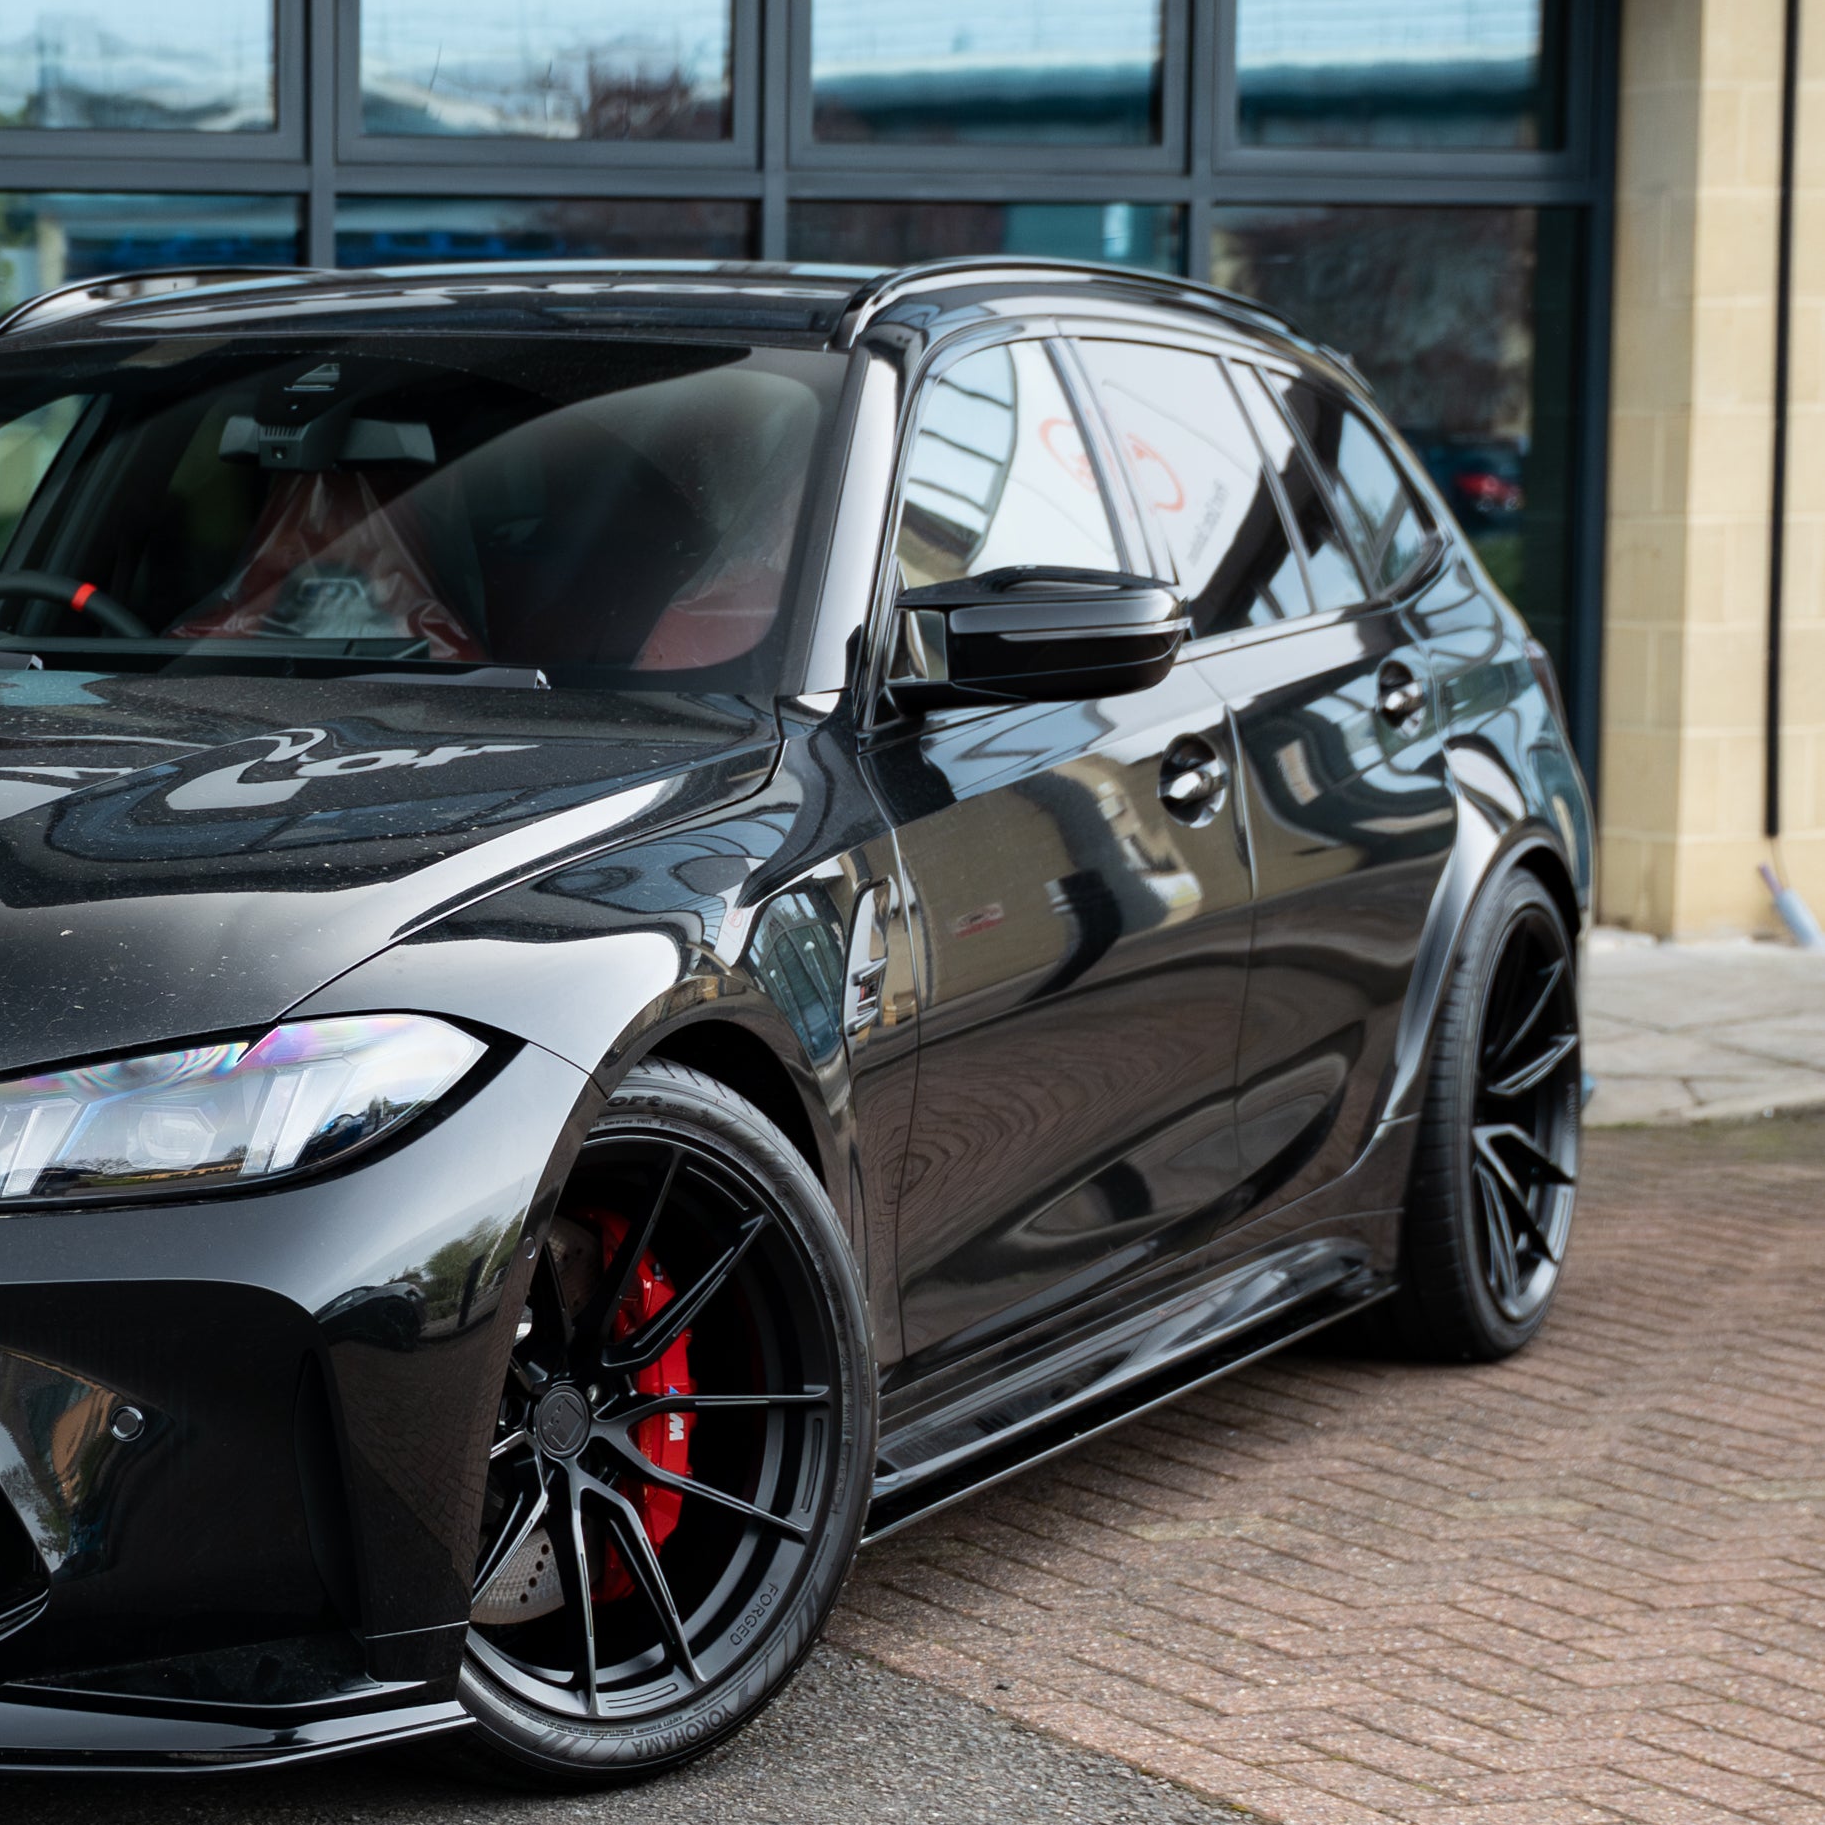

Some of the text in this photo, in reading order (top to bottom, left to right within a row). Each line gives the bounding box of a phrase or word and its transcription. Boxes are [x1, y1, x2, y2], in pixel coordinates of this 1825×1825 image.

[606, 1093, 663, 1108] ort
[729, 1582, 779, 1646] FORGED
[631, 1704, 734, 1757] YOKOHAMA
